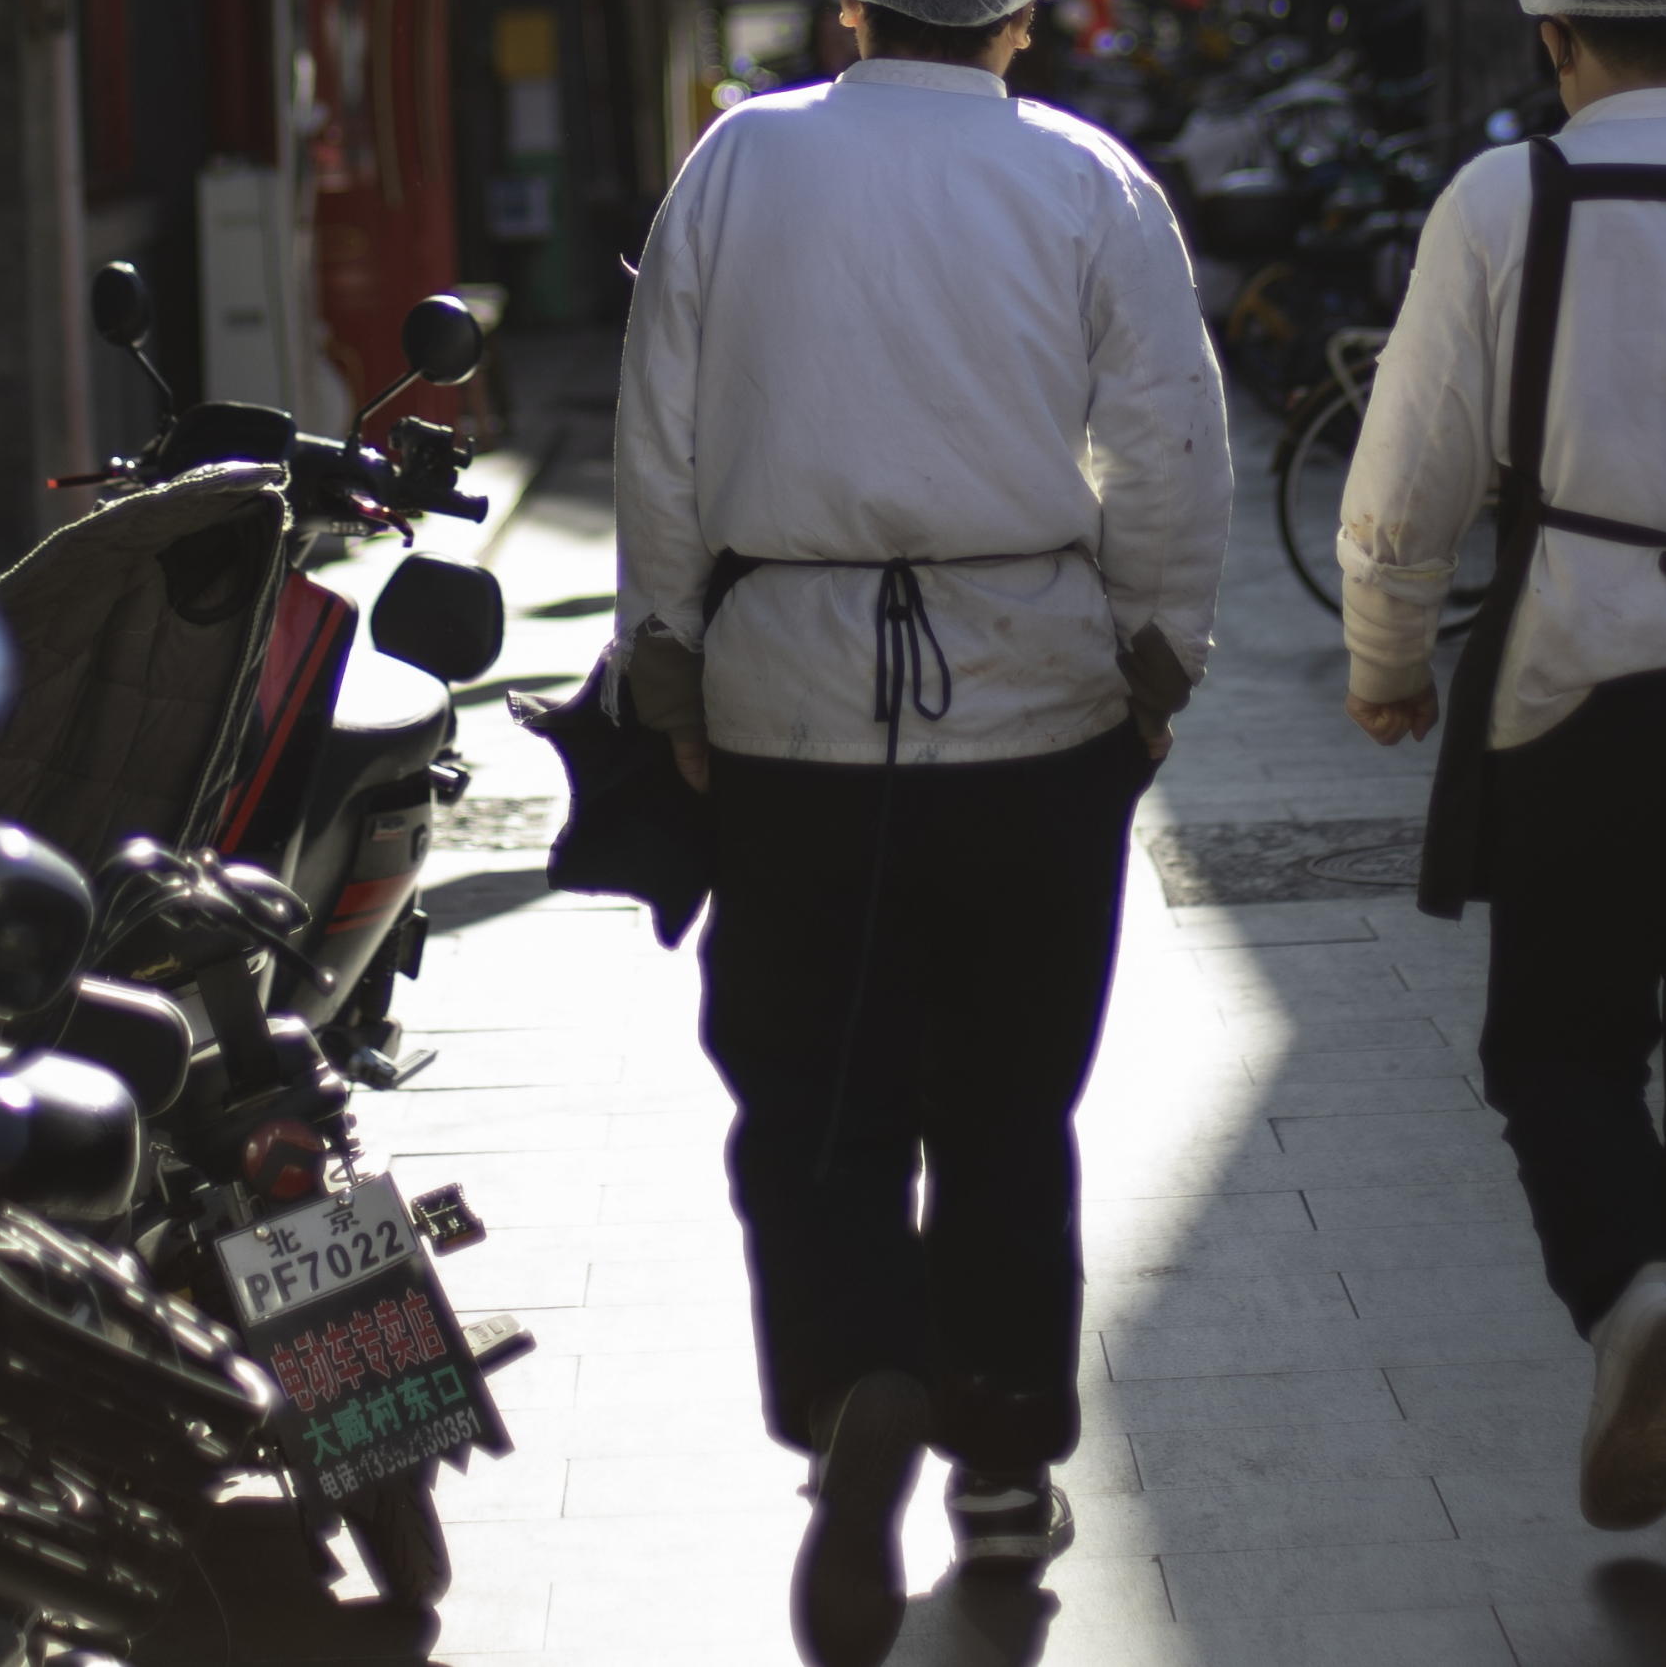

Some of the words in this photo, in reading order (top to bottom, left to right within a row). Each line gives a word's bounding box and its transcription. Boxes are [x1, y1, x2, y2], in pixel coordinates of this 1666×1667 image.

[245, 1220, 405, 1313] PF7022
[270, 1287, 447, 1413] 电动车专卖店
